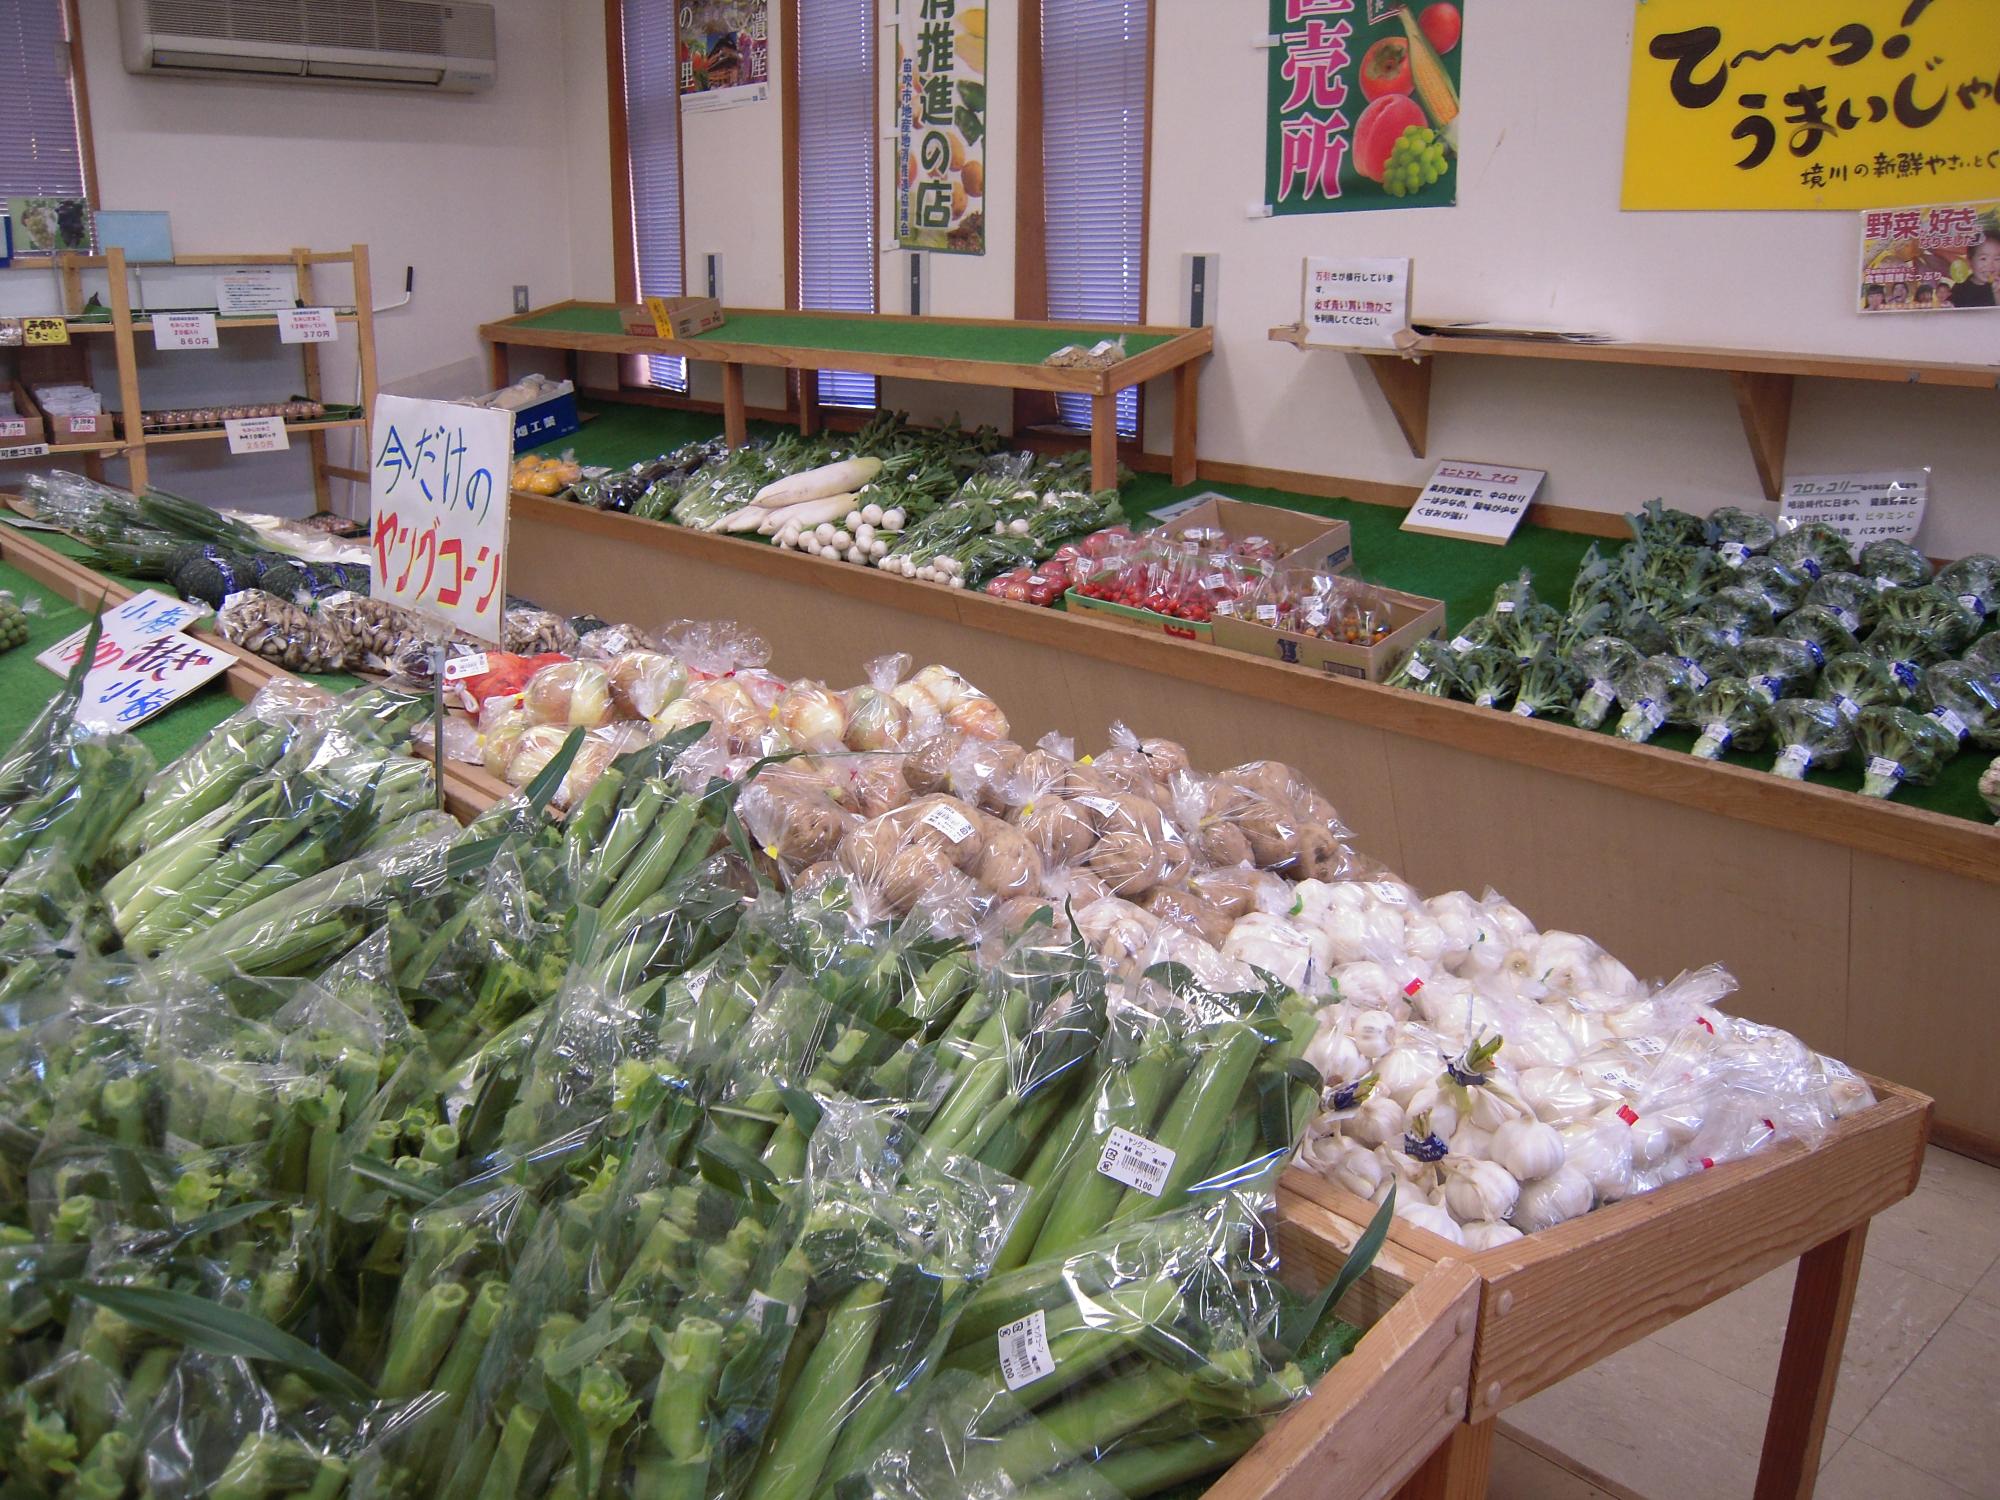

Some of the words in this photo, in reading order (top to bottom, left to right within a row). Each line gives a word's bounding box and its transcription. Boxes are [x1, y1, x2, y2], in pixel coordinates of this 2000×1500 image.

[752, 0, 768, 78] 遺産
[1278, 0, 1355, 203] 売所
[1731, 57, 2000, 170] うまいじゃ
[376, 425, 493, 527] 今だけの
[373, 508, 501, 613] ヤングコーン
